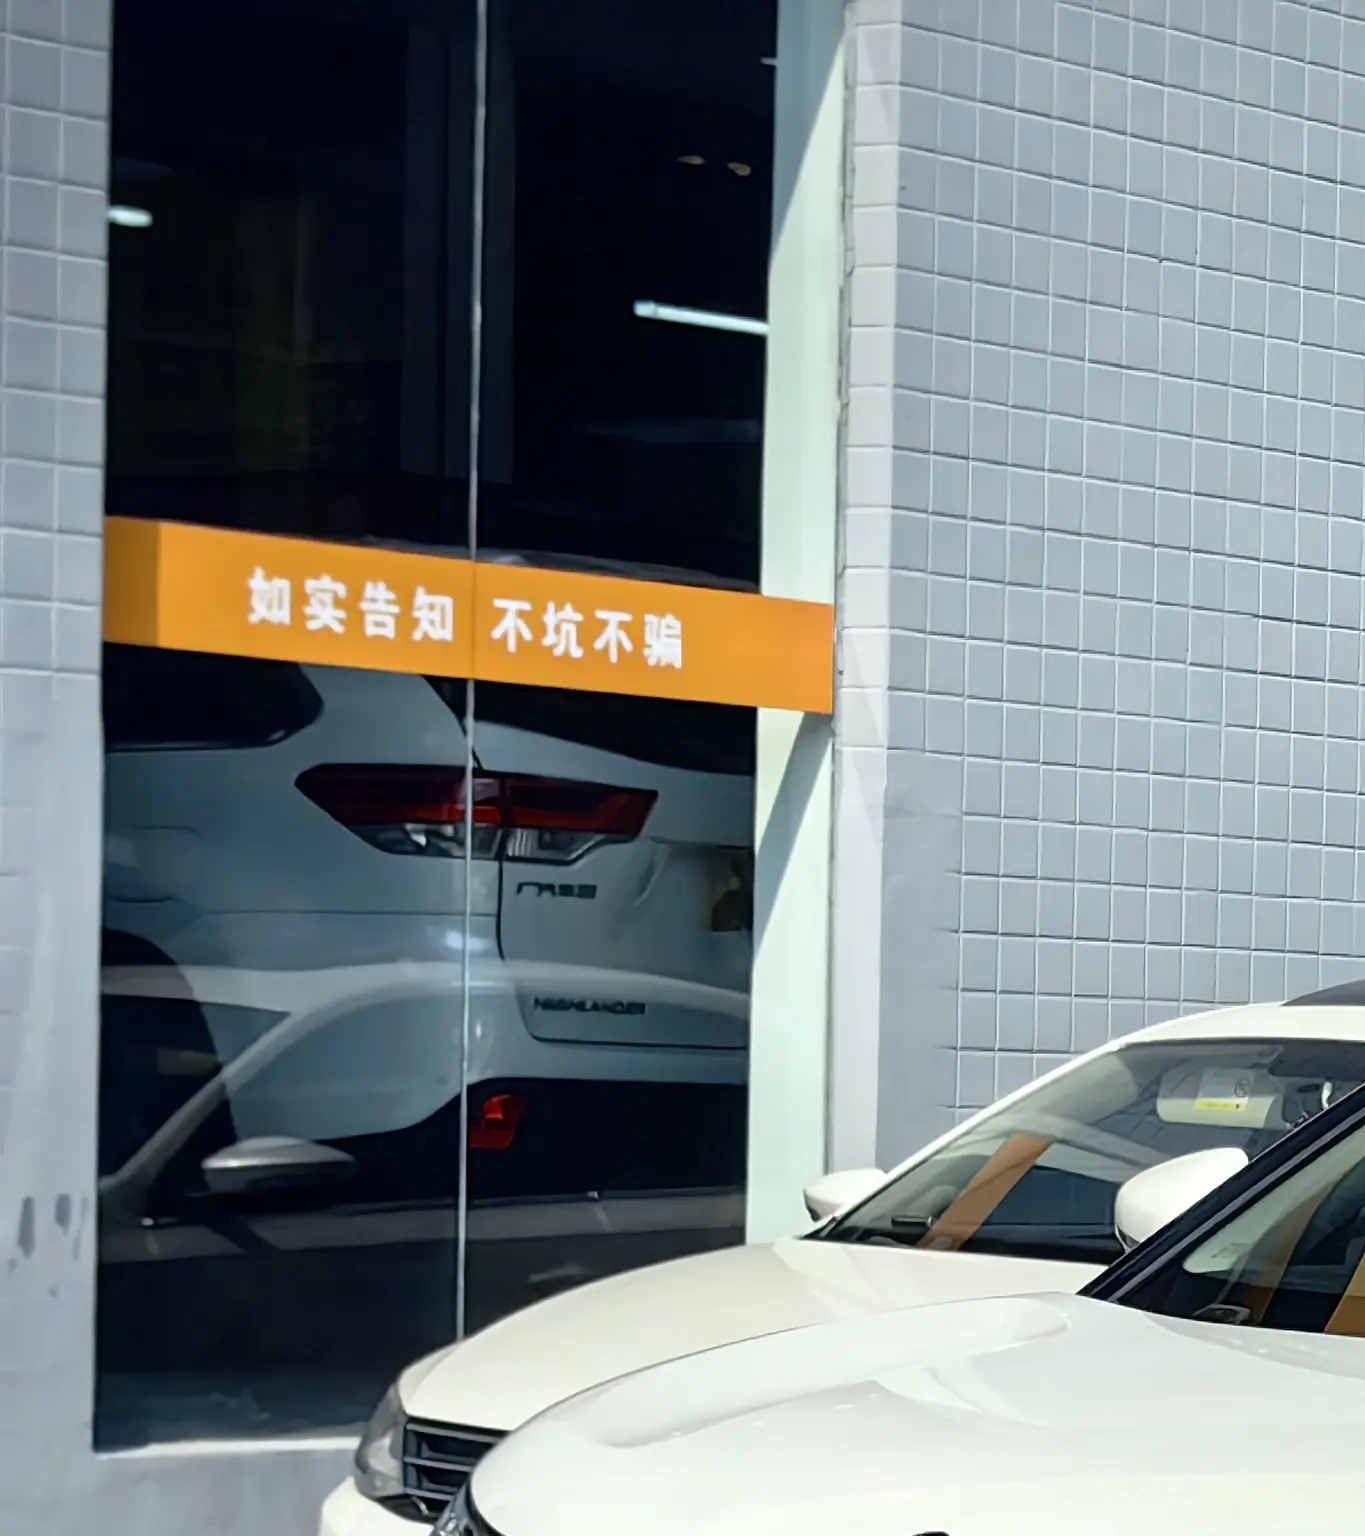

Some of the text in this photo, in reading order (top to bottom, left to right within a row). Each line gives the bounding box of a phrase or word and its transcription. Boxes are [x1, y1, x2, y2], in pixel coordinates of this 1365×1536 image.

[247, 565, 683, 669] 如实告知 不坑不骗
